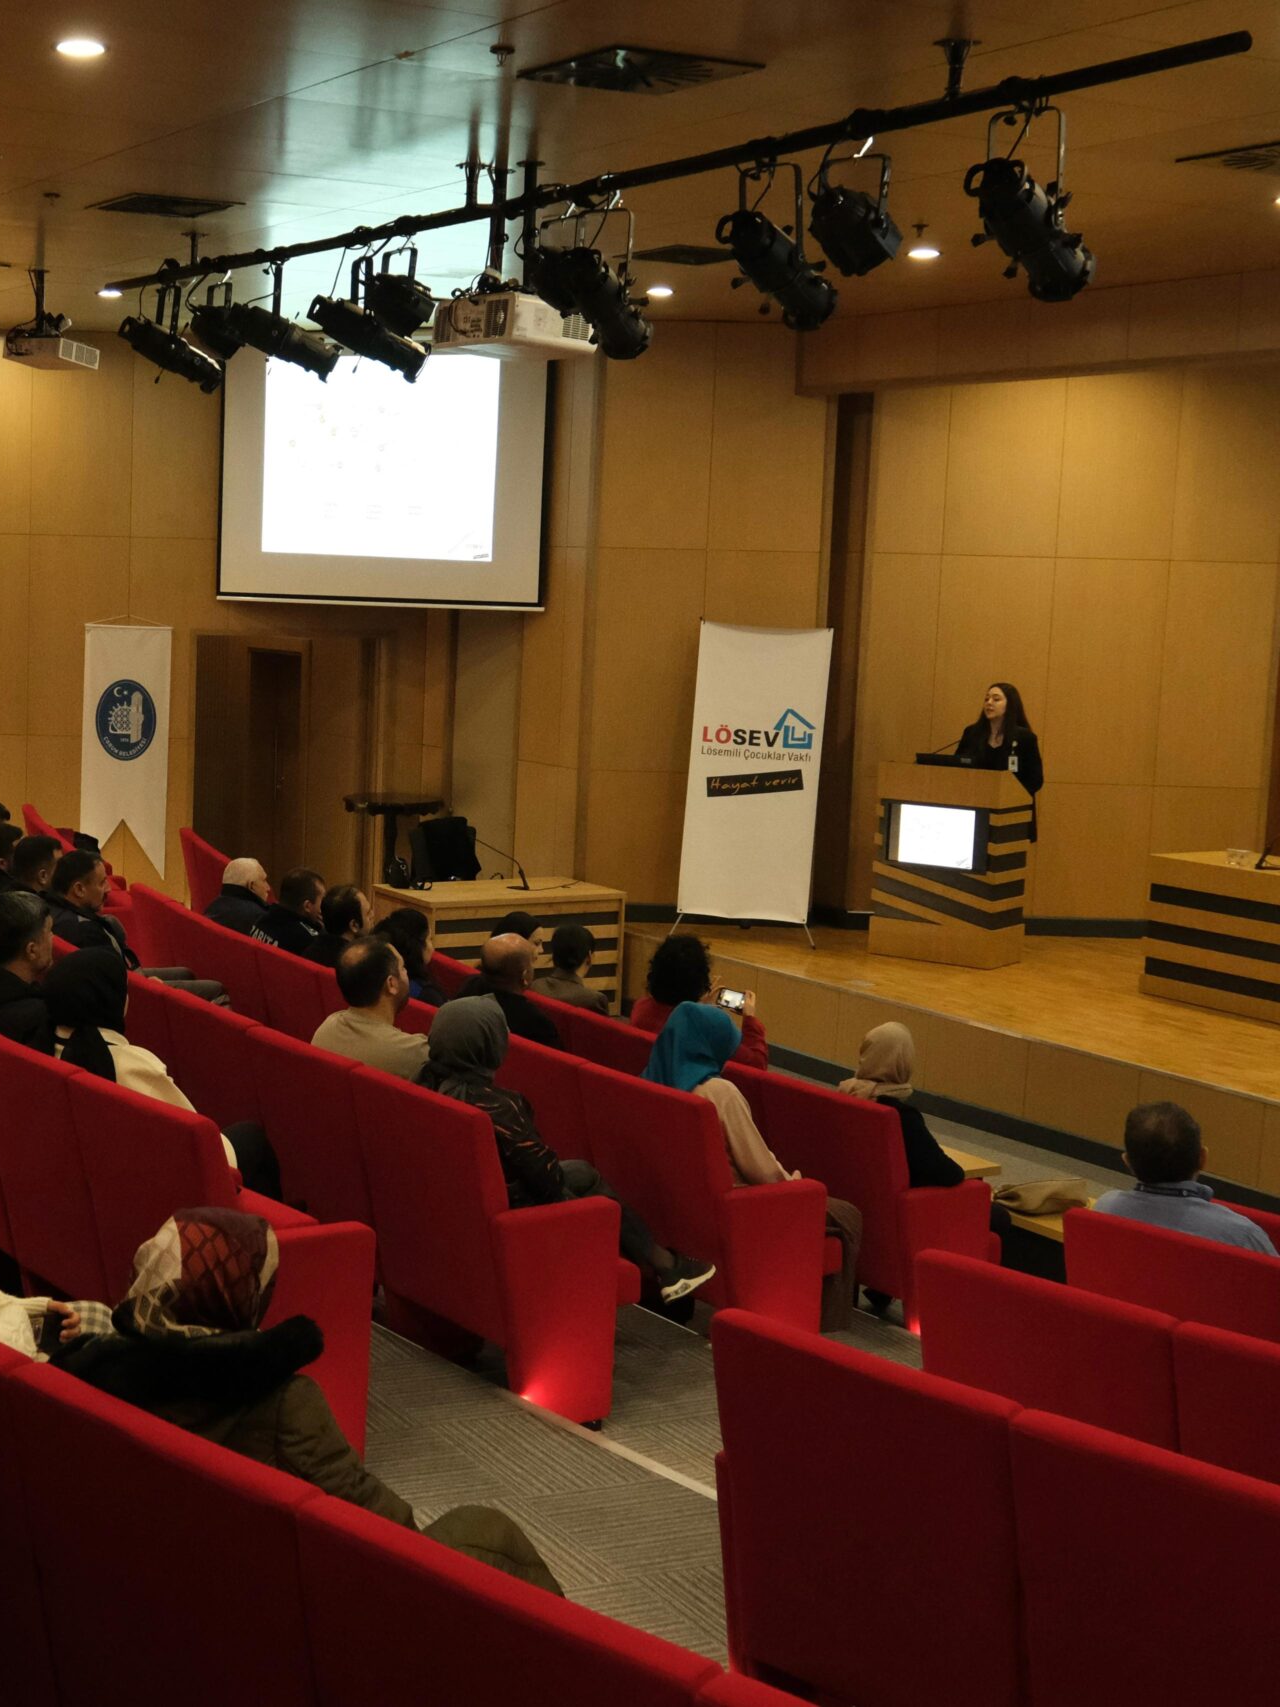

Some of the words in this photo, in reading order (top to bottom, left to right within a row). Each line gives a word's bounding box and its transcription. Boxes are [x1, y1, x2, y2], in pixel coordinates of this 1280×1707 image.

[702, 724, 780, 747] LÖSEV
[701, 746, 741, 758] Lösemili
[743, 749, 786, 760] Çocuklar
[787, 752, 812, 762] Vakfı
[710, 775, 759, 795] Hayat
[764, 776, 799, 787] verir
